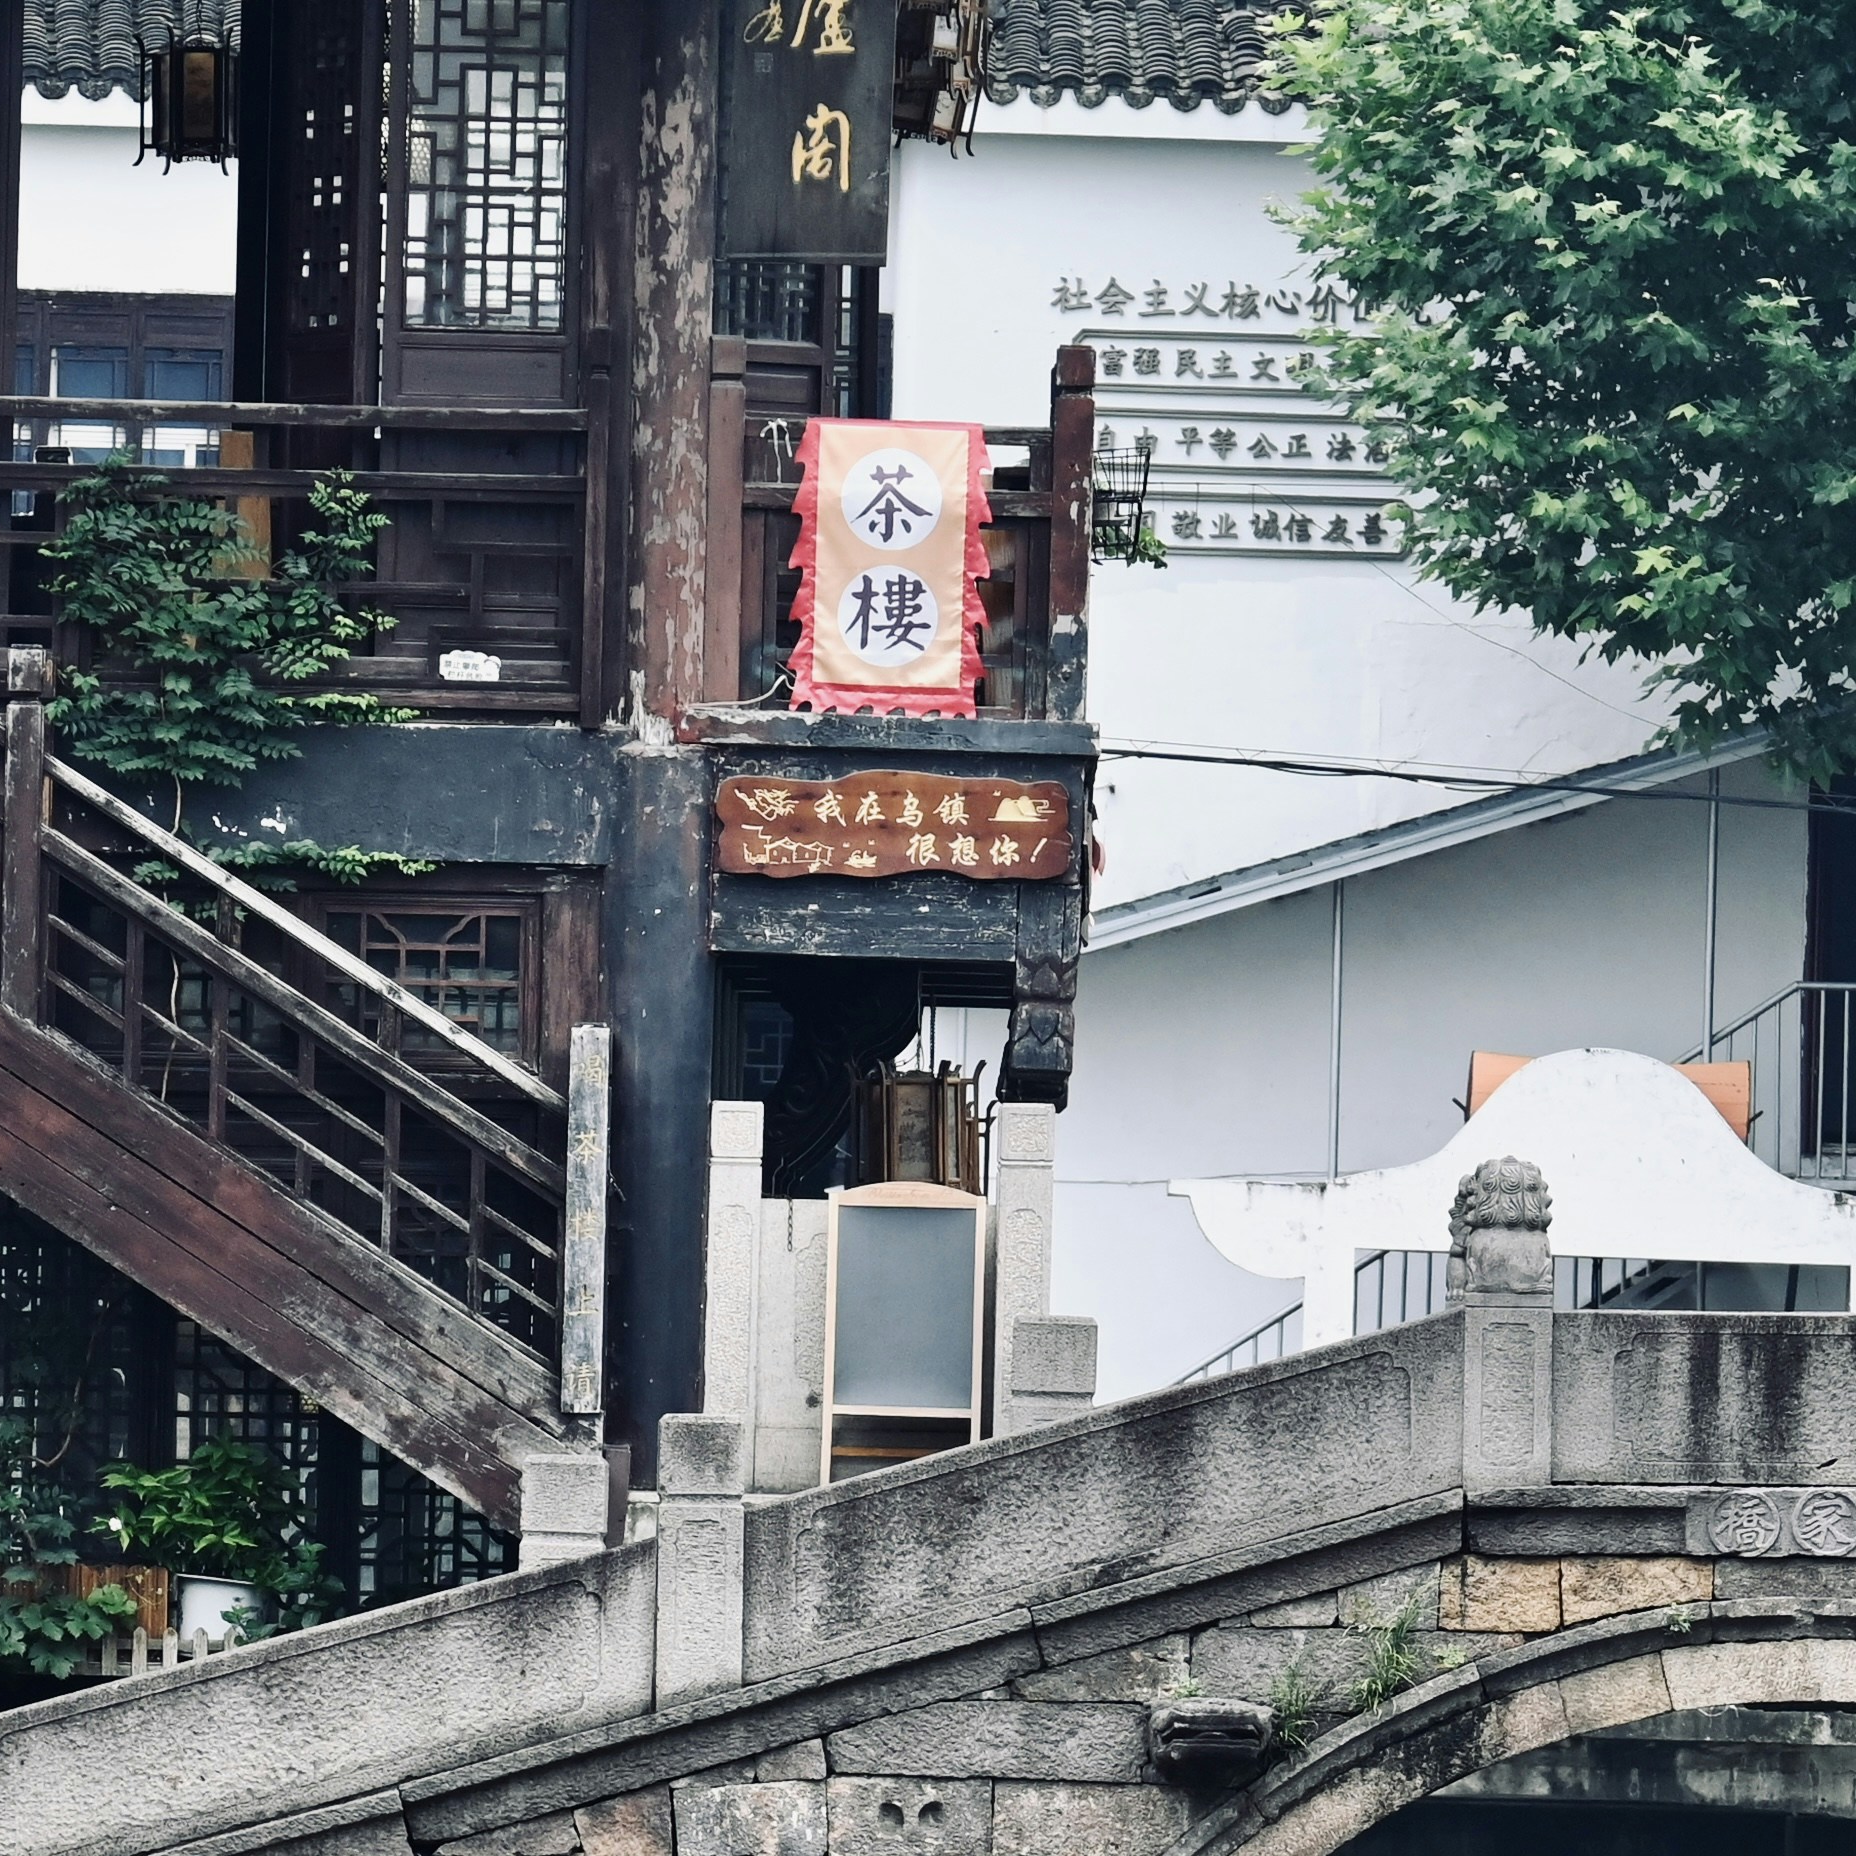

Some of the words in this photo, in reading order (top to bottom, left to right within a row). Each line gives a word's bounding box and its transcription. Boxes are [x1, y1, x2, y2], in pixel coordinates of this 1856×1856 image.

[1051, 277, 1432, 326] 社会主义核心价
[1099, 345, 1161, 377] 富强
[1174, 348, 1238, 379] 民主
[1097, 422, 1159, 456] 自由
[1175, 426, 1238, 461] 平等
[1247, 432, 1312, 460] 公正
[1171, 509, 1239, 540] 敬业
[1252, 508, 1313, 543] 诚信
[1321, 513, 1388, 545] 友善
[845, 464, 933, 651] 茶樓
[813, 789, 970, 828] 我在乌镇
